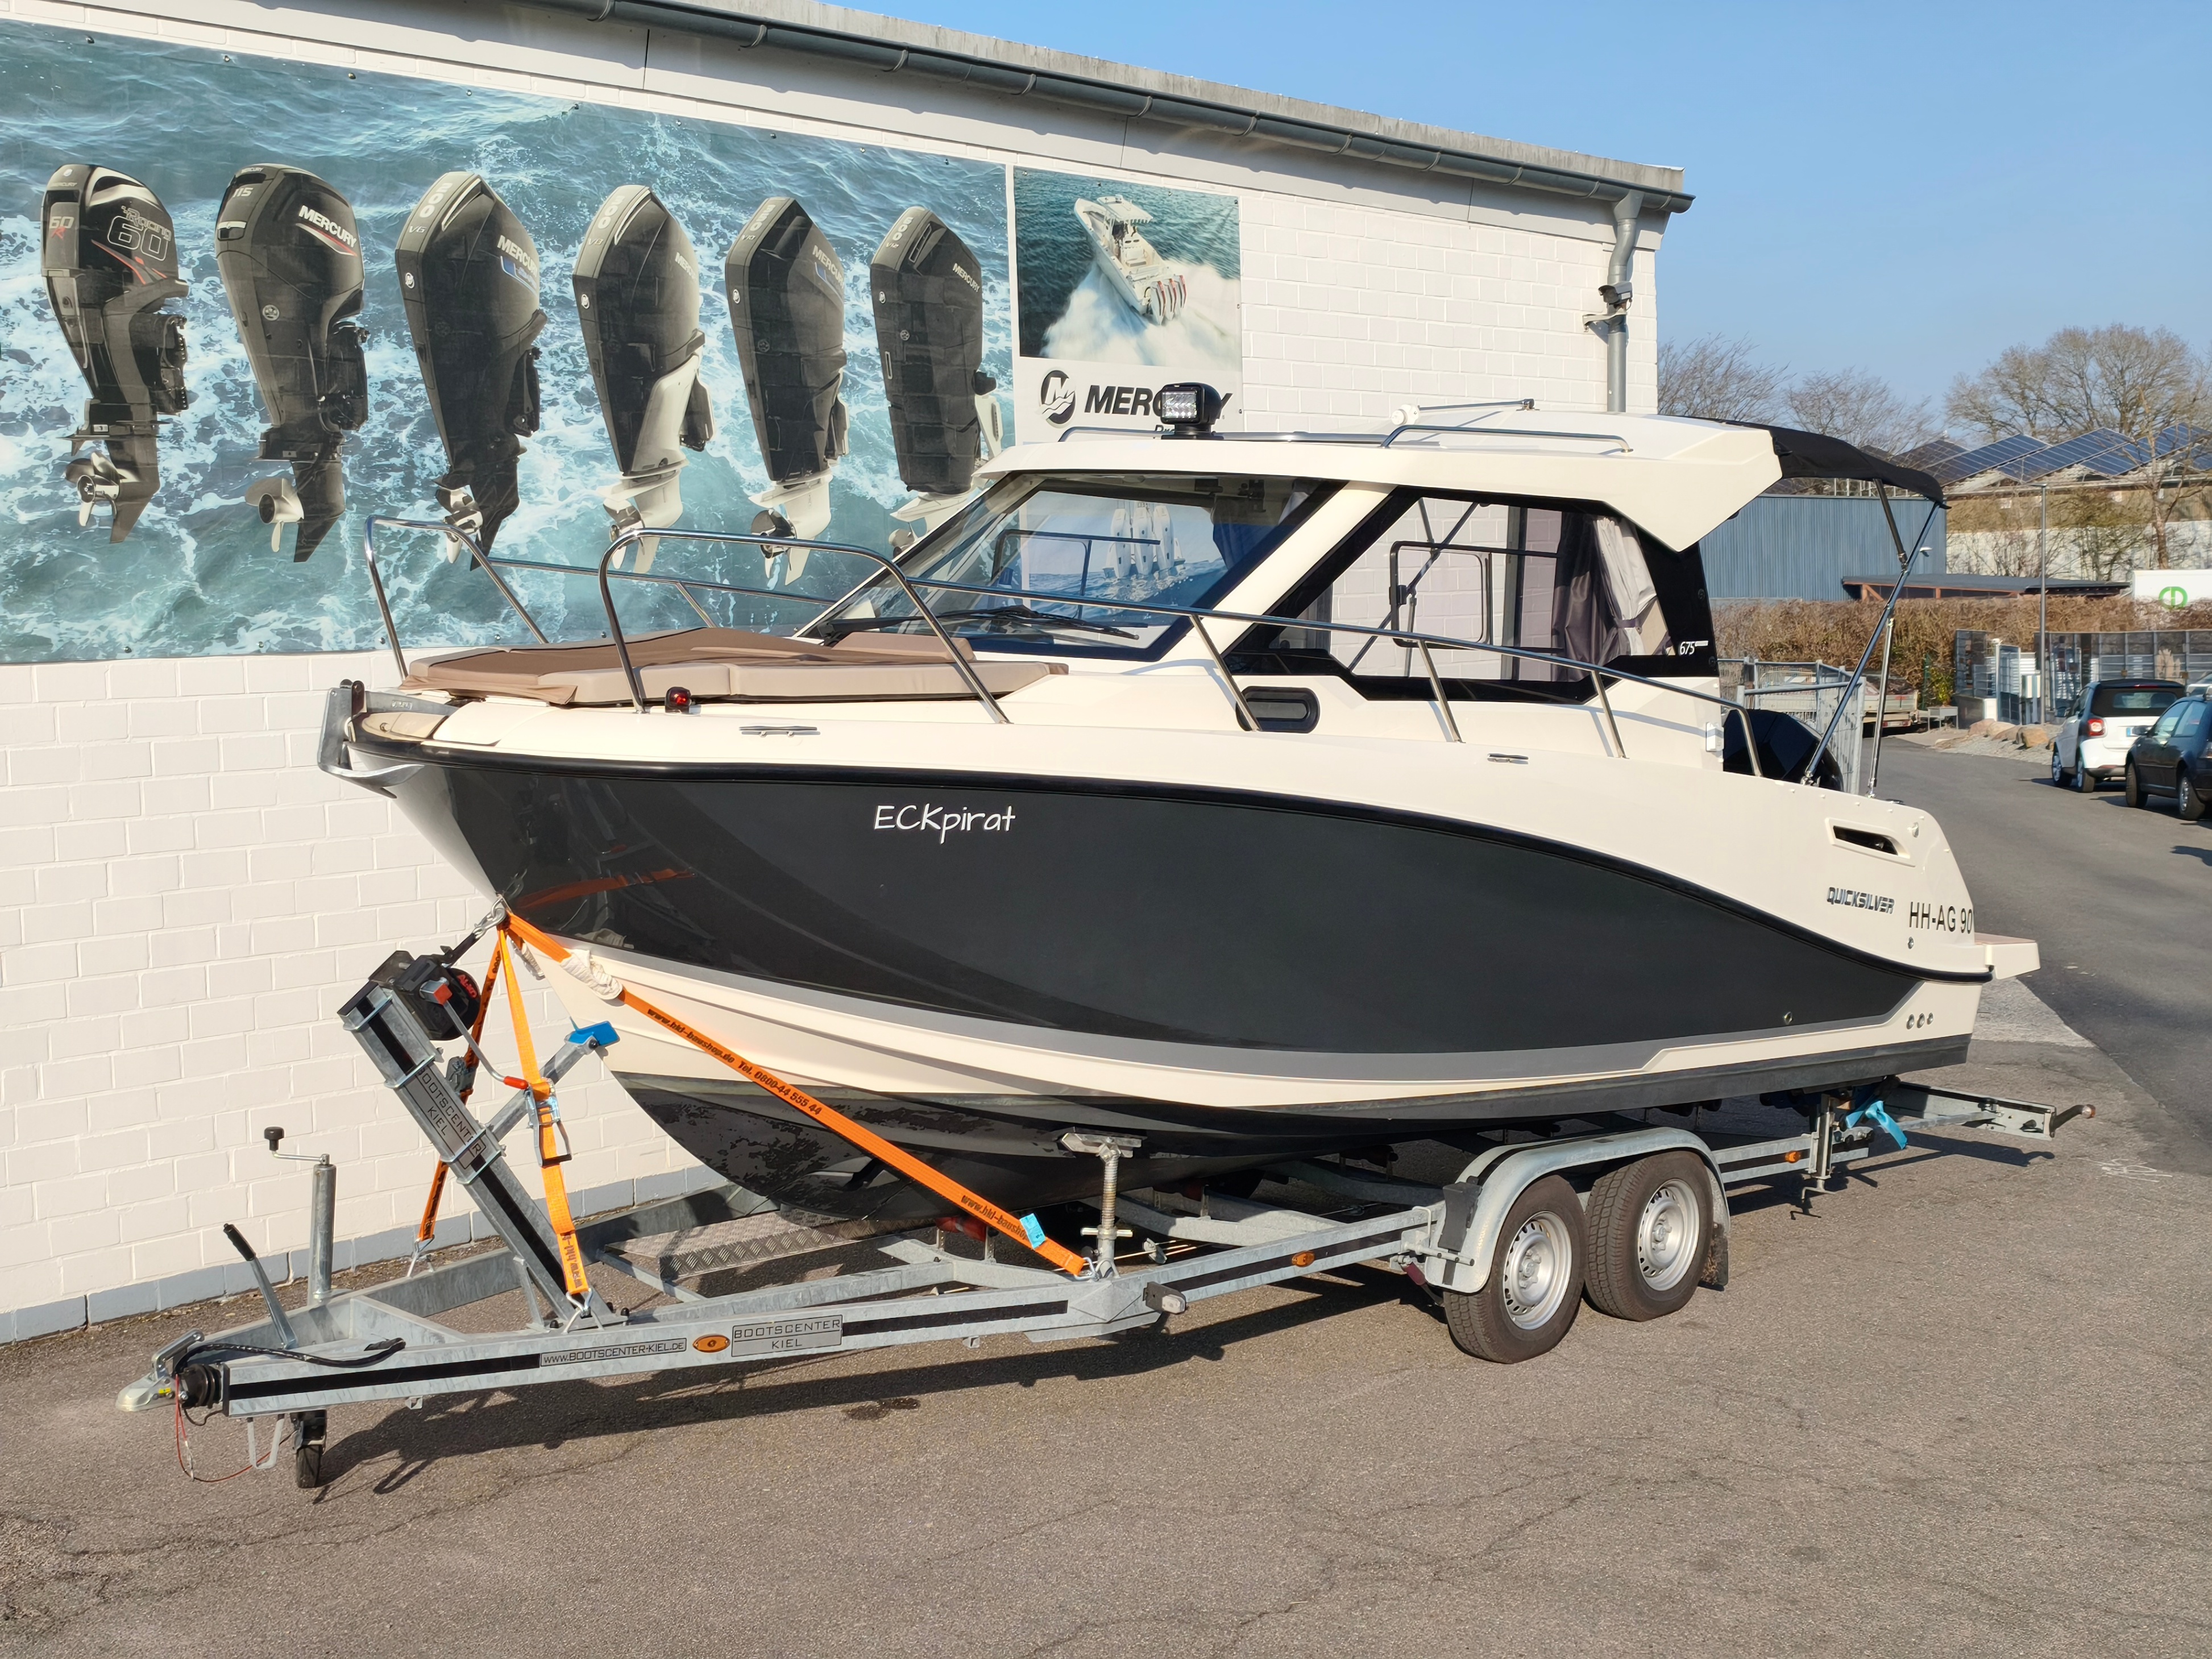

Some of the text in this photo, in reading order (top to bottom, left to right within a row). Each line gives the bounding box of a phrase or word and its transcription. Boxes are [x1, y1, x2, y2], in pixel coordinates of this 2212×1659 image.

[233, 187, 254, 198] 115
[420, 183, 453, 218] 200
[50, 216, 74, 229] 60
[125, 207, 172, 242] Racing
[298, 205, 357, 248] MERCURY
[893, 217, 914, 241] 600
[107, 215, 169, 261] 60
[952, 263, 980, 292] MERCURY
[1680, 641, 1695, 655] 675
[874, 803, 1016, 844] ECKpirat
[1827, 887, 1895, 914] QUICKSILVER
[1909, 901, 1956, 932] HH-AG
[738, 1061, 753, 1075] Tel.
[790, 1092, 808, 1108] 555
[808, 1104, 823, 1115] 44
[428, 1106, 447, 1136] KIEL
[733, 1319, 841, 1338] BOOTSCENTER
[771, 1338, 803, 1350] KIEL
